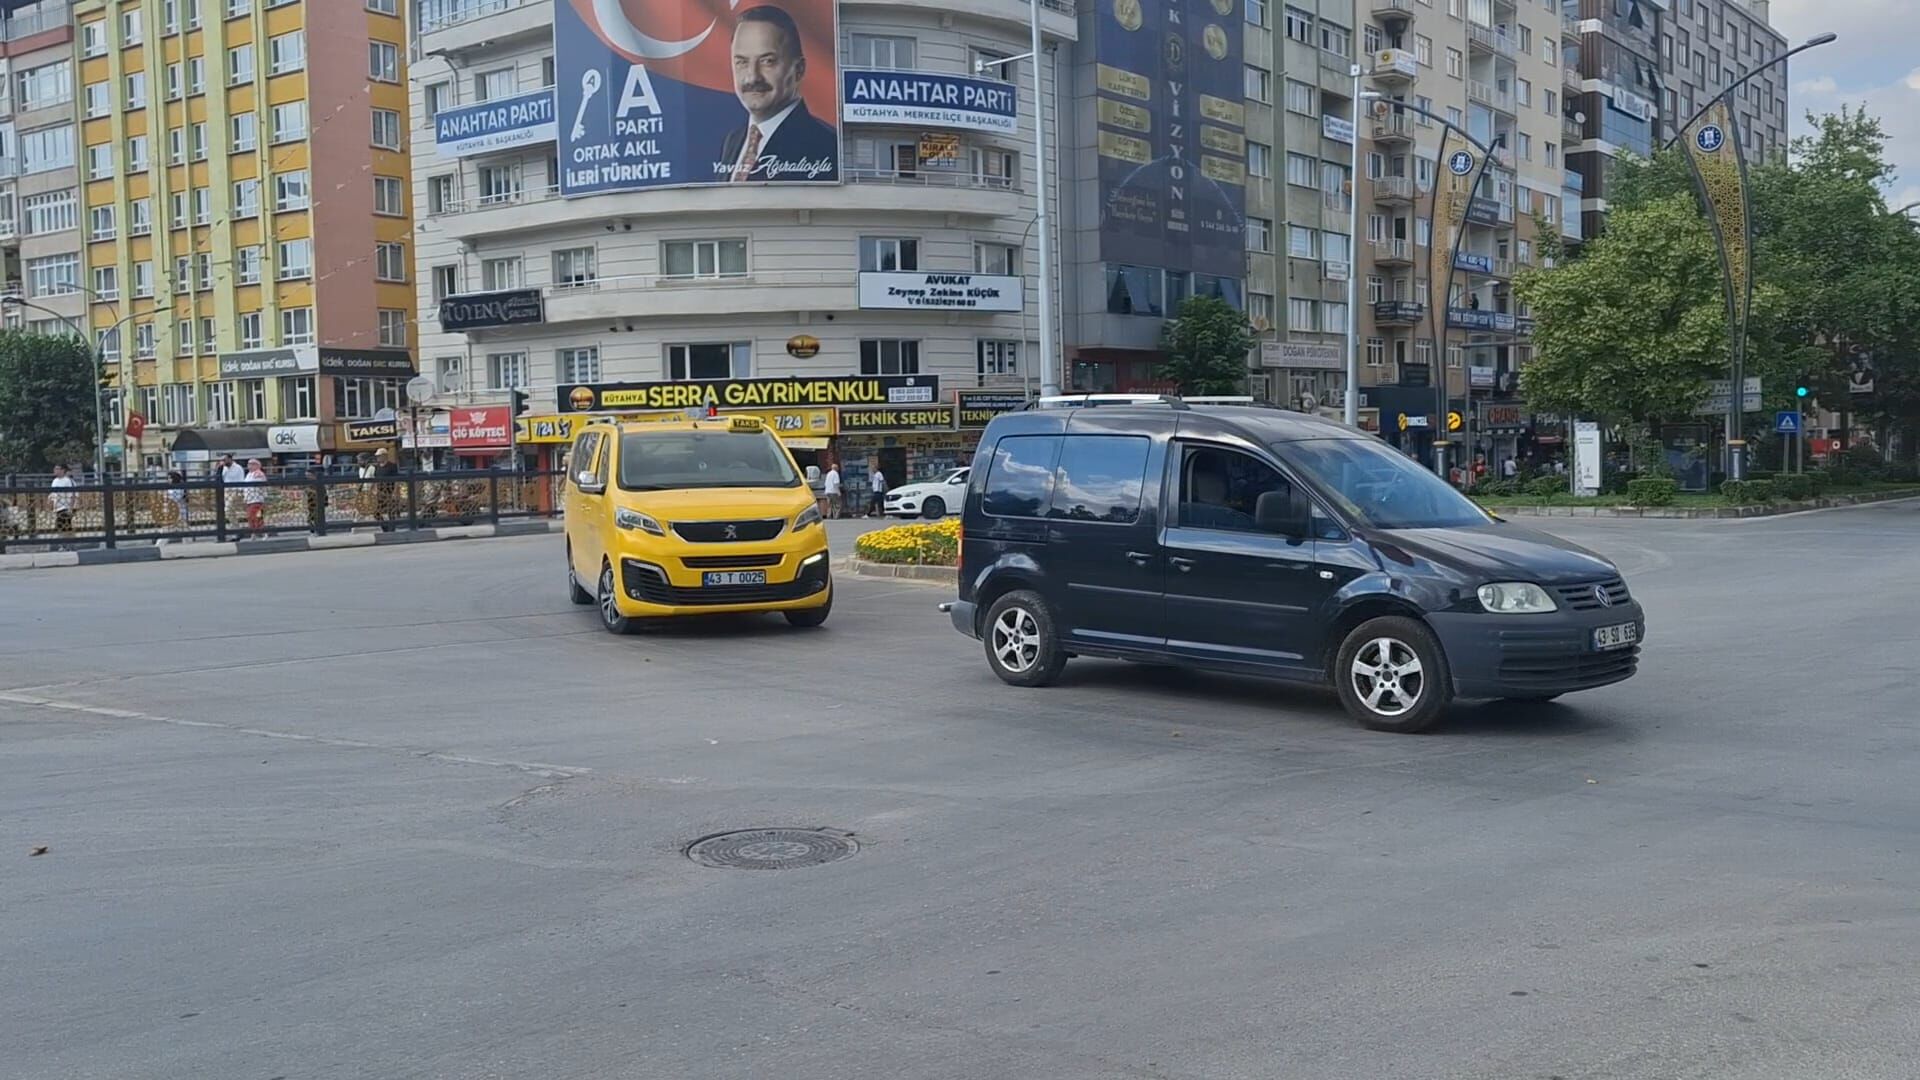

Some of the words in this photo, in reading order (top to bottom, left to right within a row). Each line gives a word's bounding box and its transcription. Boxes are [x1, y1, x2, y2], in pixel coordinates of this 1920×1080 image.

[615, 63, 662, 118] A
[852, 78, 958, 105] ANAHTAR
[963, 85, 1013, 113] PARTİ
[440, 107, 508, 139] ANAHTAR
[510, 98, 552, 126] PARTİ
[852, 107, 899, 118] KÜTAHYA
[903, 110, 941, 121] MERKEZ
[615, 117, 663, 136] PARTİ
[573, 142, 621, 163] ORTAK
[624, 139, 661, 157] AKIL
[566, 164, 600, 188] İLERİ
[601, 159, 671, 183] TÜRKİYE
[713, 161, 751, 174] Yavuz
[925, 275, 972, 286] AVUKAT
[888, 287, 926, 299] Zeynep
[966, 288, 1001, 300] KÜÇÜK
[604, 393, 645, 404] KÜTAHYA
[648, 384, 720, 408] SERRA
[724, 380, 886, 406] GAYRİMENKUL
[774, 415, 803, 431] 7/24
[842, 410, 898, 427] TEKNİK
[900, 408, 951, 426] SERVİS
[708, 573, 722, 584] 43
[728, 573, 734, 584] T
[738, 572, 764, 584] 0025
